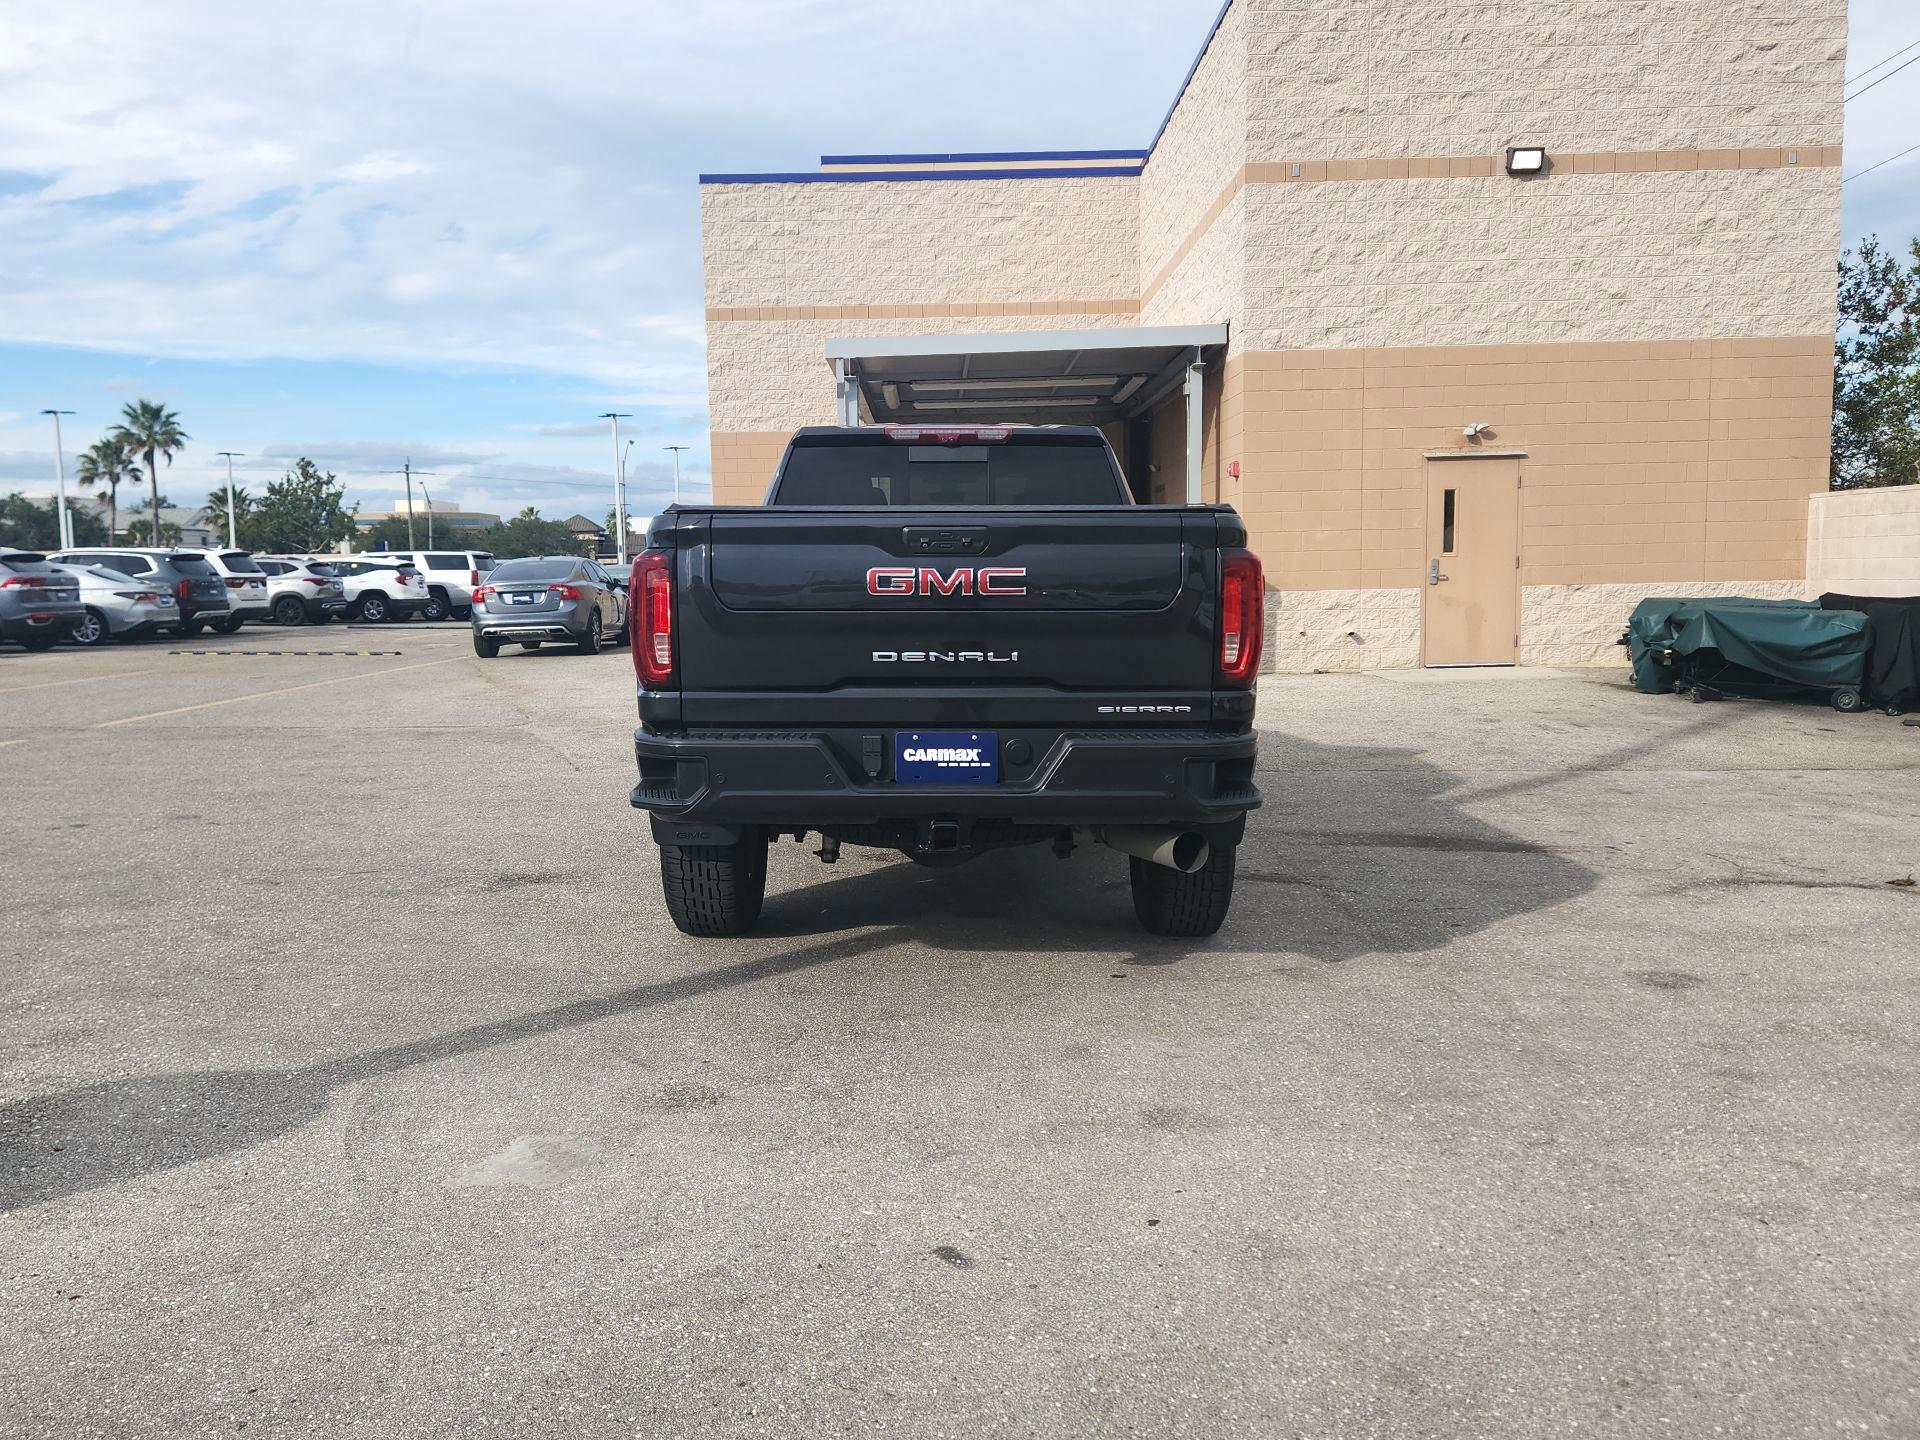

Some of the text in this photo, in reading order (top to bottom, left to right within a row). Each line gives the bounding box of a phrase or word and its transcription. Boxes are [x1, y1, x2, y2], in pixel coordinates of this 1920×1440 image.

[866, 567, 1027, 597] GMC
[872, 651, 1019, 662] DENALI
[1097, 705, 1192, 713] SIERRA
[675, 831, 712, 840] GMC
